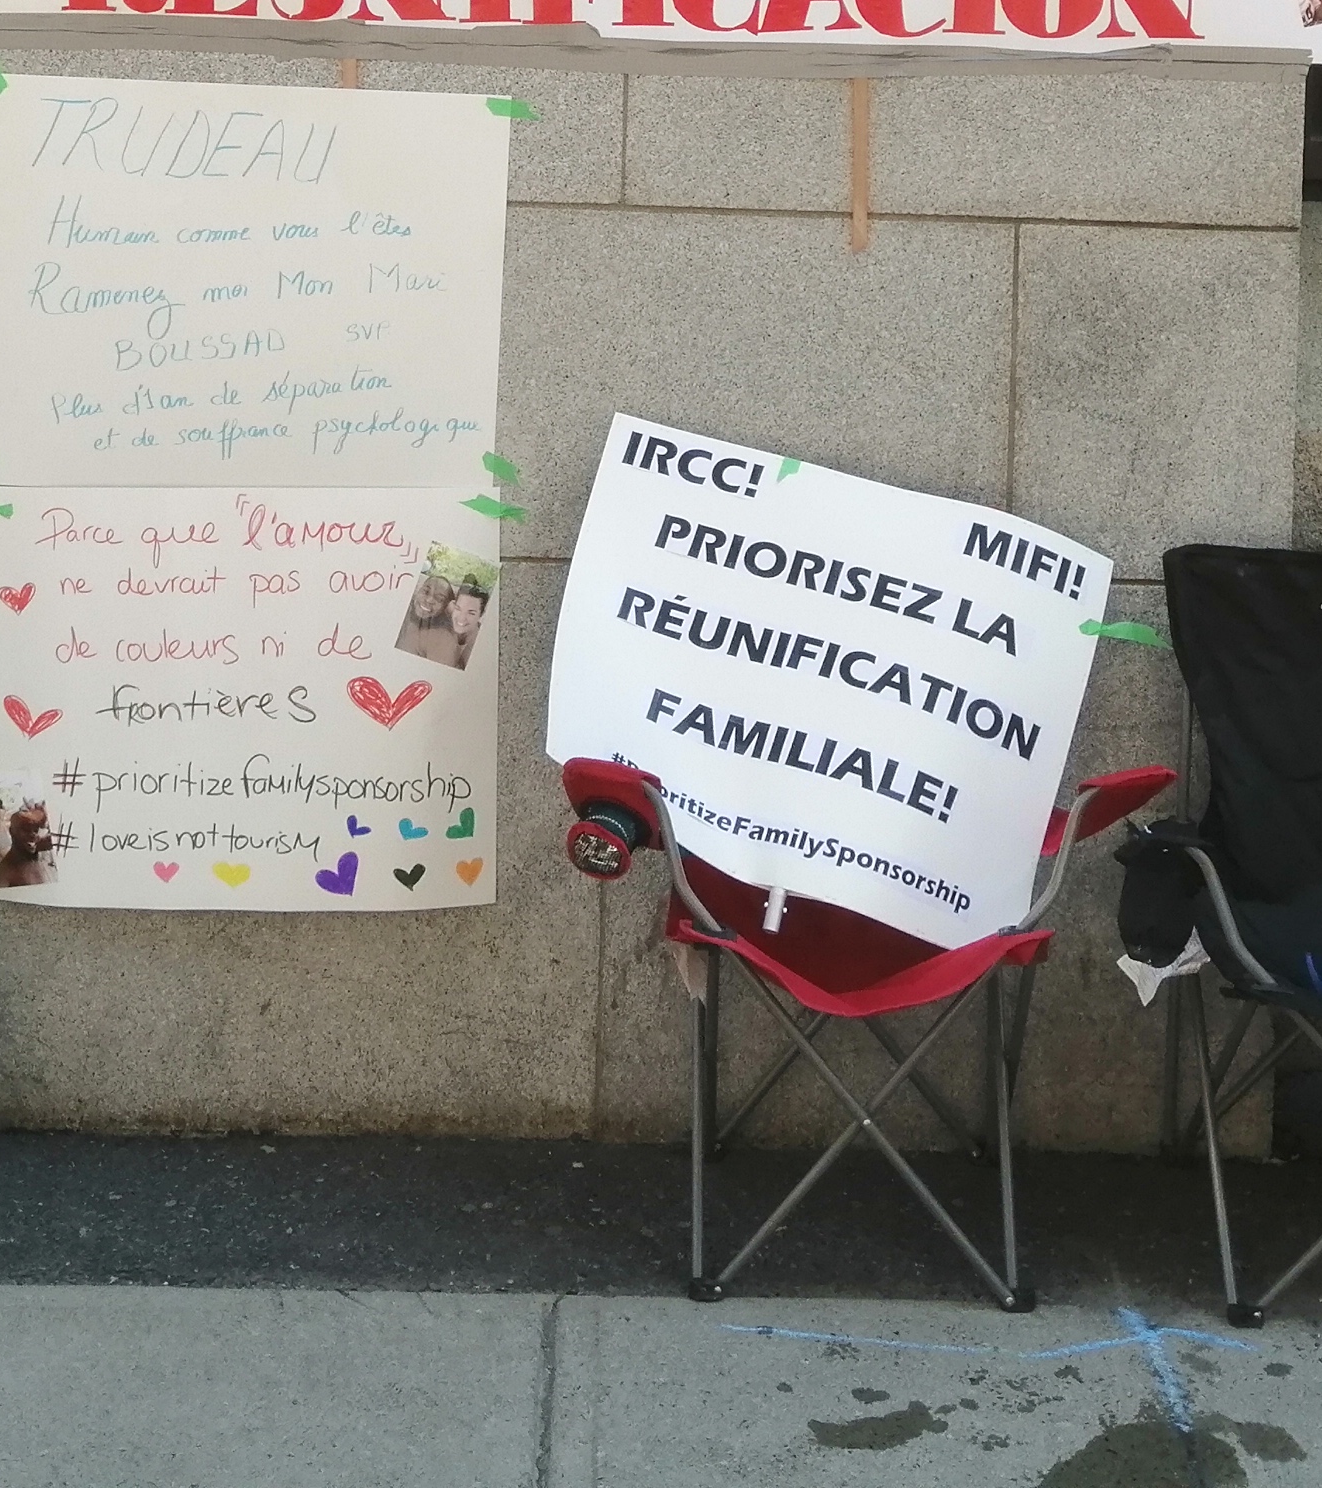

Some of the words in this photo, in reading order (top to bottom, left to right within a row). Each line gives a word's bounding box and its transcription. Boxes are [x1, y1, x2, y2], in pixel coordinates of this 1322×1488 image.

[30, 97, 338, 185] TRUDEAU
[277, 269, 334, 301] Mon
[368, 262, 448, 294] Mari
[115, 329, 285, 370] BOUSSAD
[210, 379, 243, 407] de
[93, 427, 120, 451] et
[132, 423, 161, 448] de
[621, 430, 766, 499] IRCC!
[35, 507, 124, 551] Parce
[140, 520, 221, 567] que
[961, 521, 1088, 601] MIFI!
[60, 575, 93, 596] ne
[116, 564, 227, 597] devrait
[248, 569, 300, 608] pas
[328, 564, 417, 594] avoir
[653, 513, 945, 625] PRIORISEZ
[950, 598, 1018, 658] LA
[55, 627, 98, 663] de
[115, 632, 240, 665] couleurs
[260, 630, 285, 659] ni
[317, 622, 373, 661] de
[616, 585, 1042, 762] RÉUNIFICATION
[645, 688, 960, 824] FAMILIALE!
